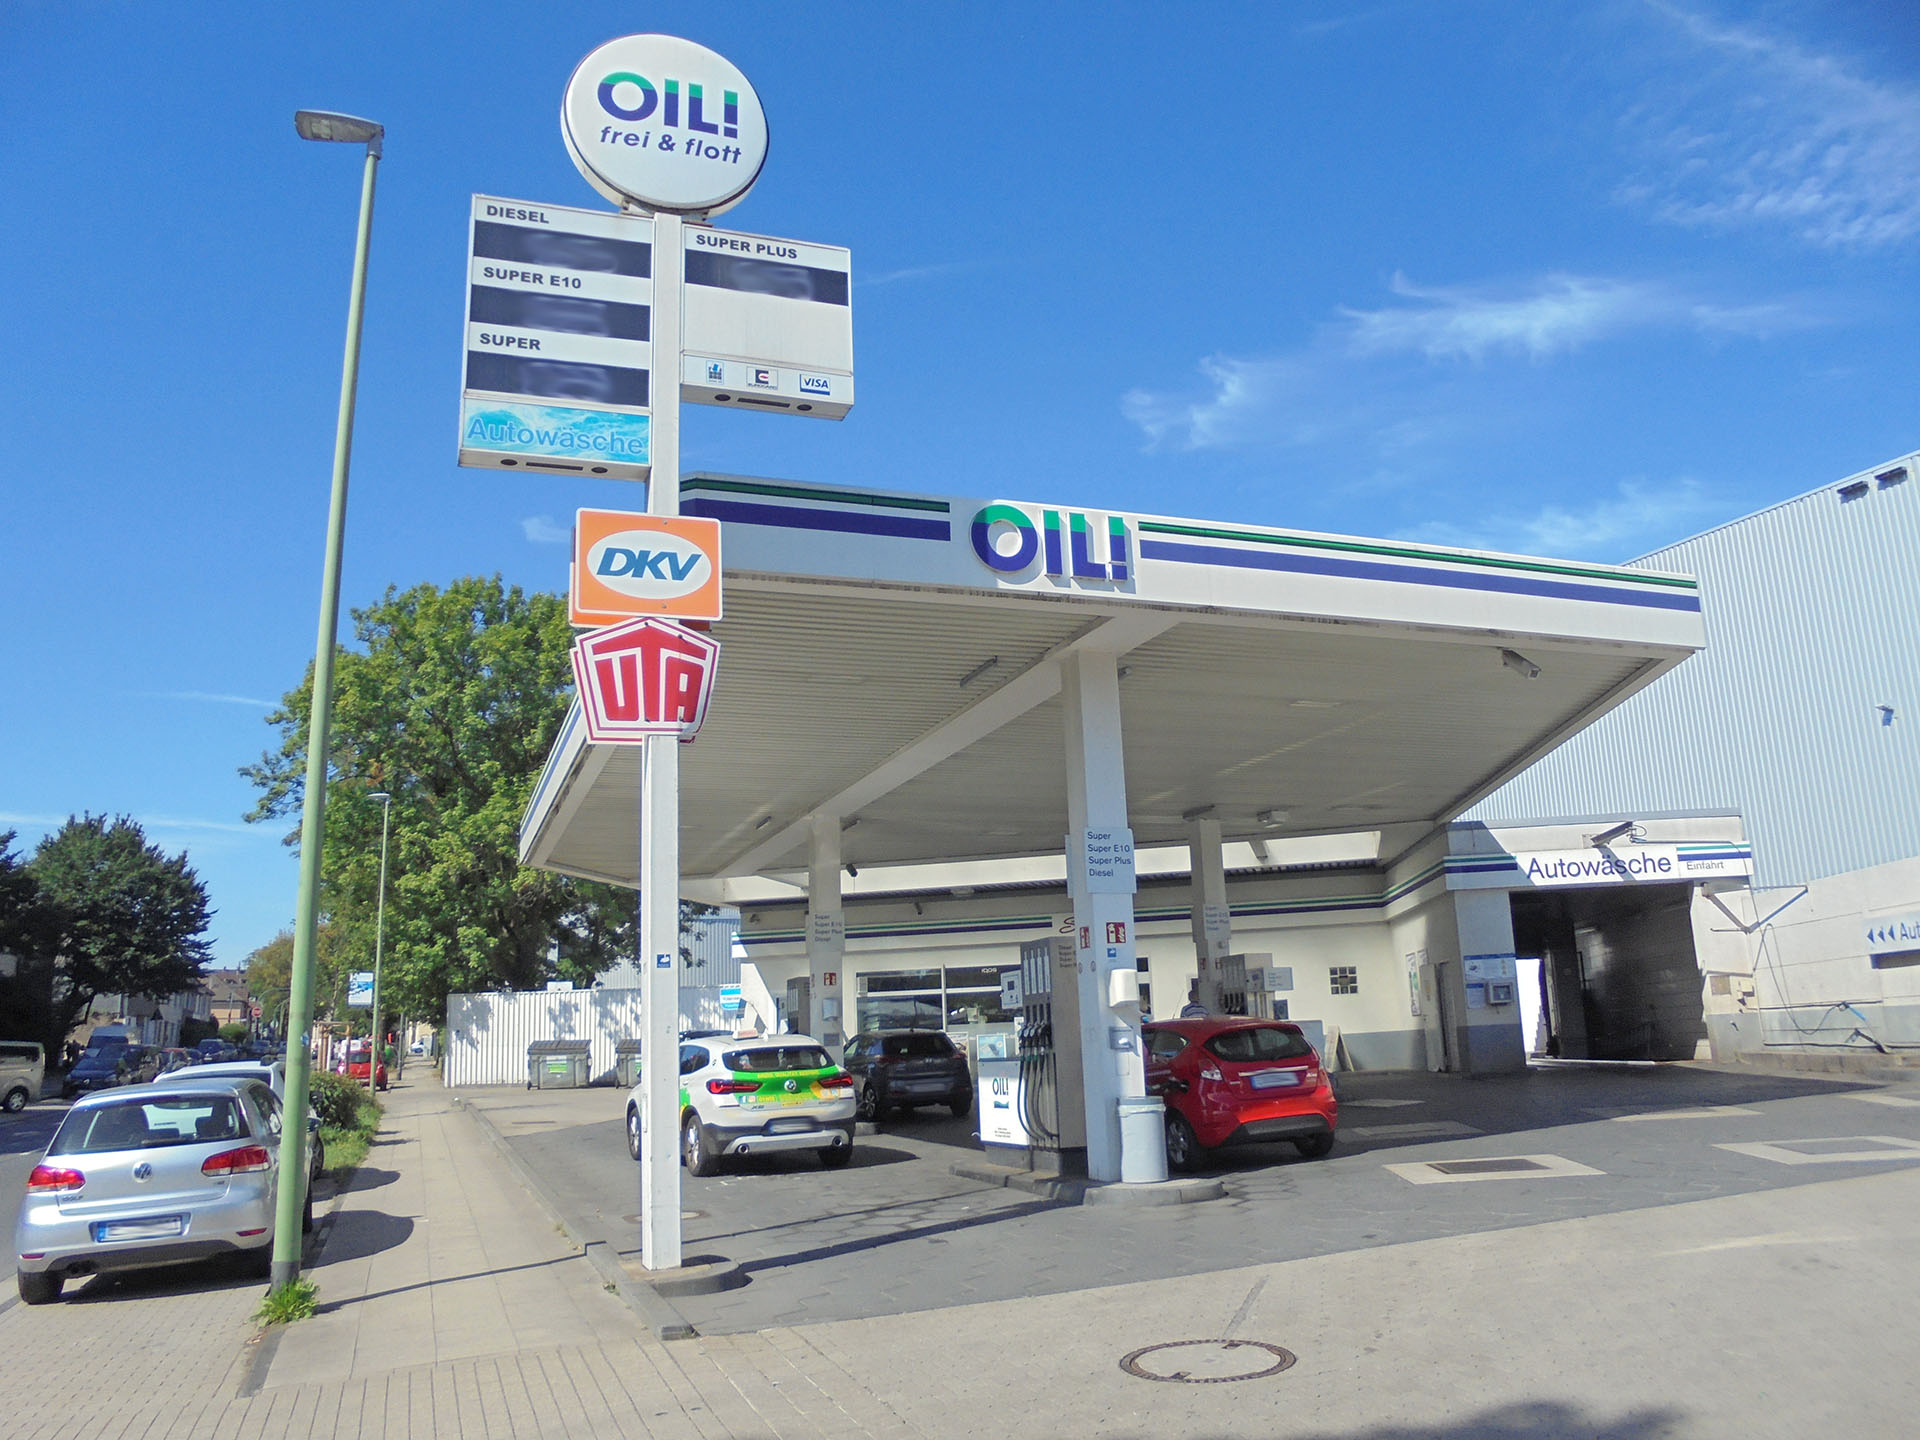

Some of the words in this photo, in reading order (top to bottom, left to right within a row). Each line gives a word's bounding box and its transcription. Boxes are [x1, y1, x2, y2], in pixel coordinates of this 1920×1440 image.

[597, 71, 738, 139] OIL!
[600, 126, 651, 148] frei
[658, 134, 676, 152] &
[685, 138, 742, 164] flott
[486, 205, 550, 224] DIESEL
[696, 234, 750, 252] SUPER
[756, 243, 798, 259] PLUS
[483, 266, 543, 285] SUPER
[550, 274, 582, 289] E10
[480, 333, 541, 350] SUPER
[803, 377, 829, 389] VISA
[467, 418, 643, 455] Autowäsche
[971, 504, 1128, 581] OIL!
[596, 547, 702, 581] DKV
[591, 623, 707, 723] UTA
[1087, 831, 1111, 841] Super
[1087, 843, 1111, 853] Super
[1114, 844, 1130, 853] E10
[1088, 856, 1112, 866] Super
[1114, 856, 1132, 865] Plus
[1088, 868, 1114, 877] Diesel
[1526, 851, 1672, 879] Autowäsche
[992, 1077, 1009, 1096] OIL!
